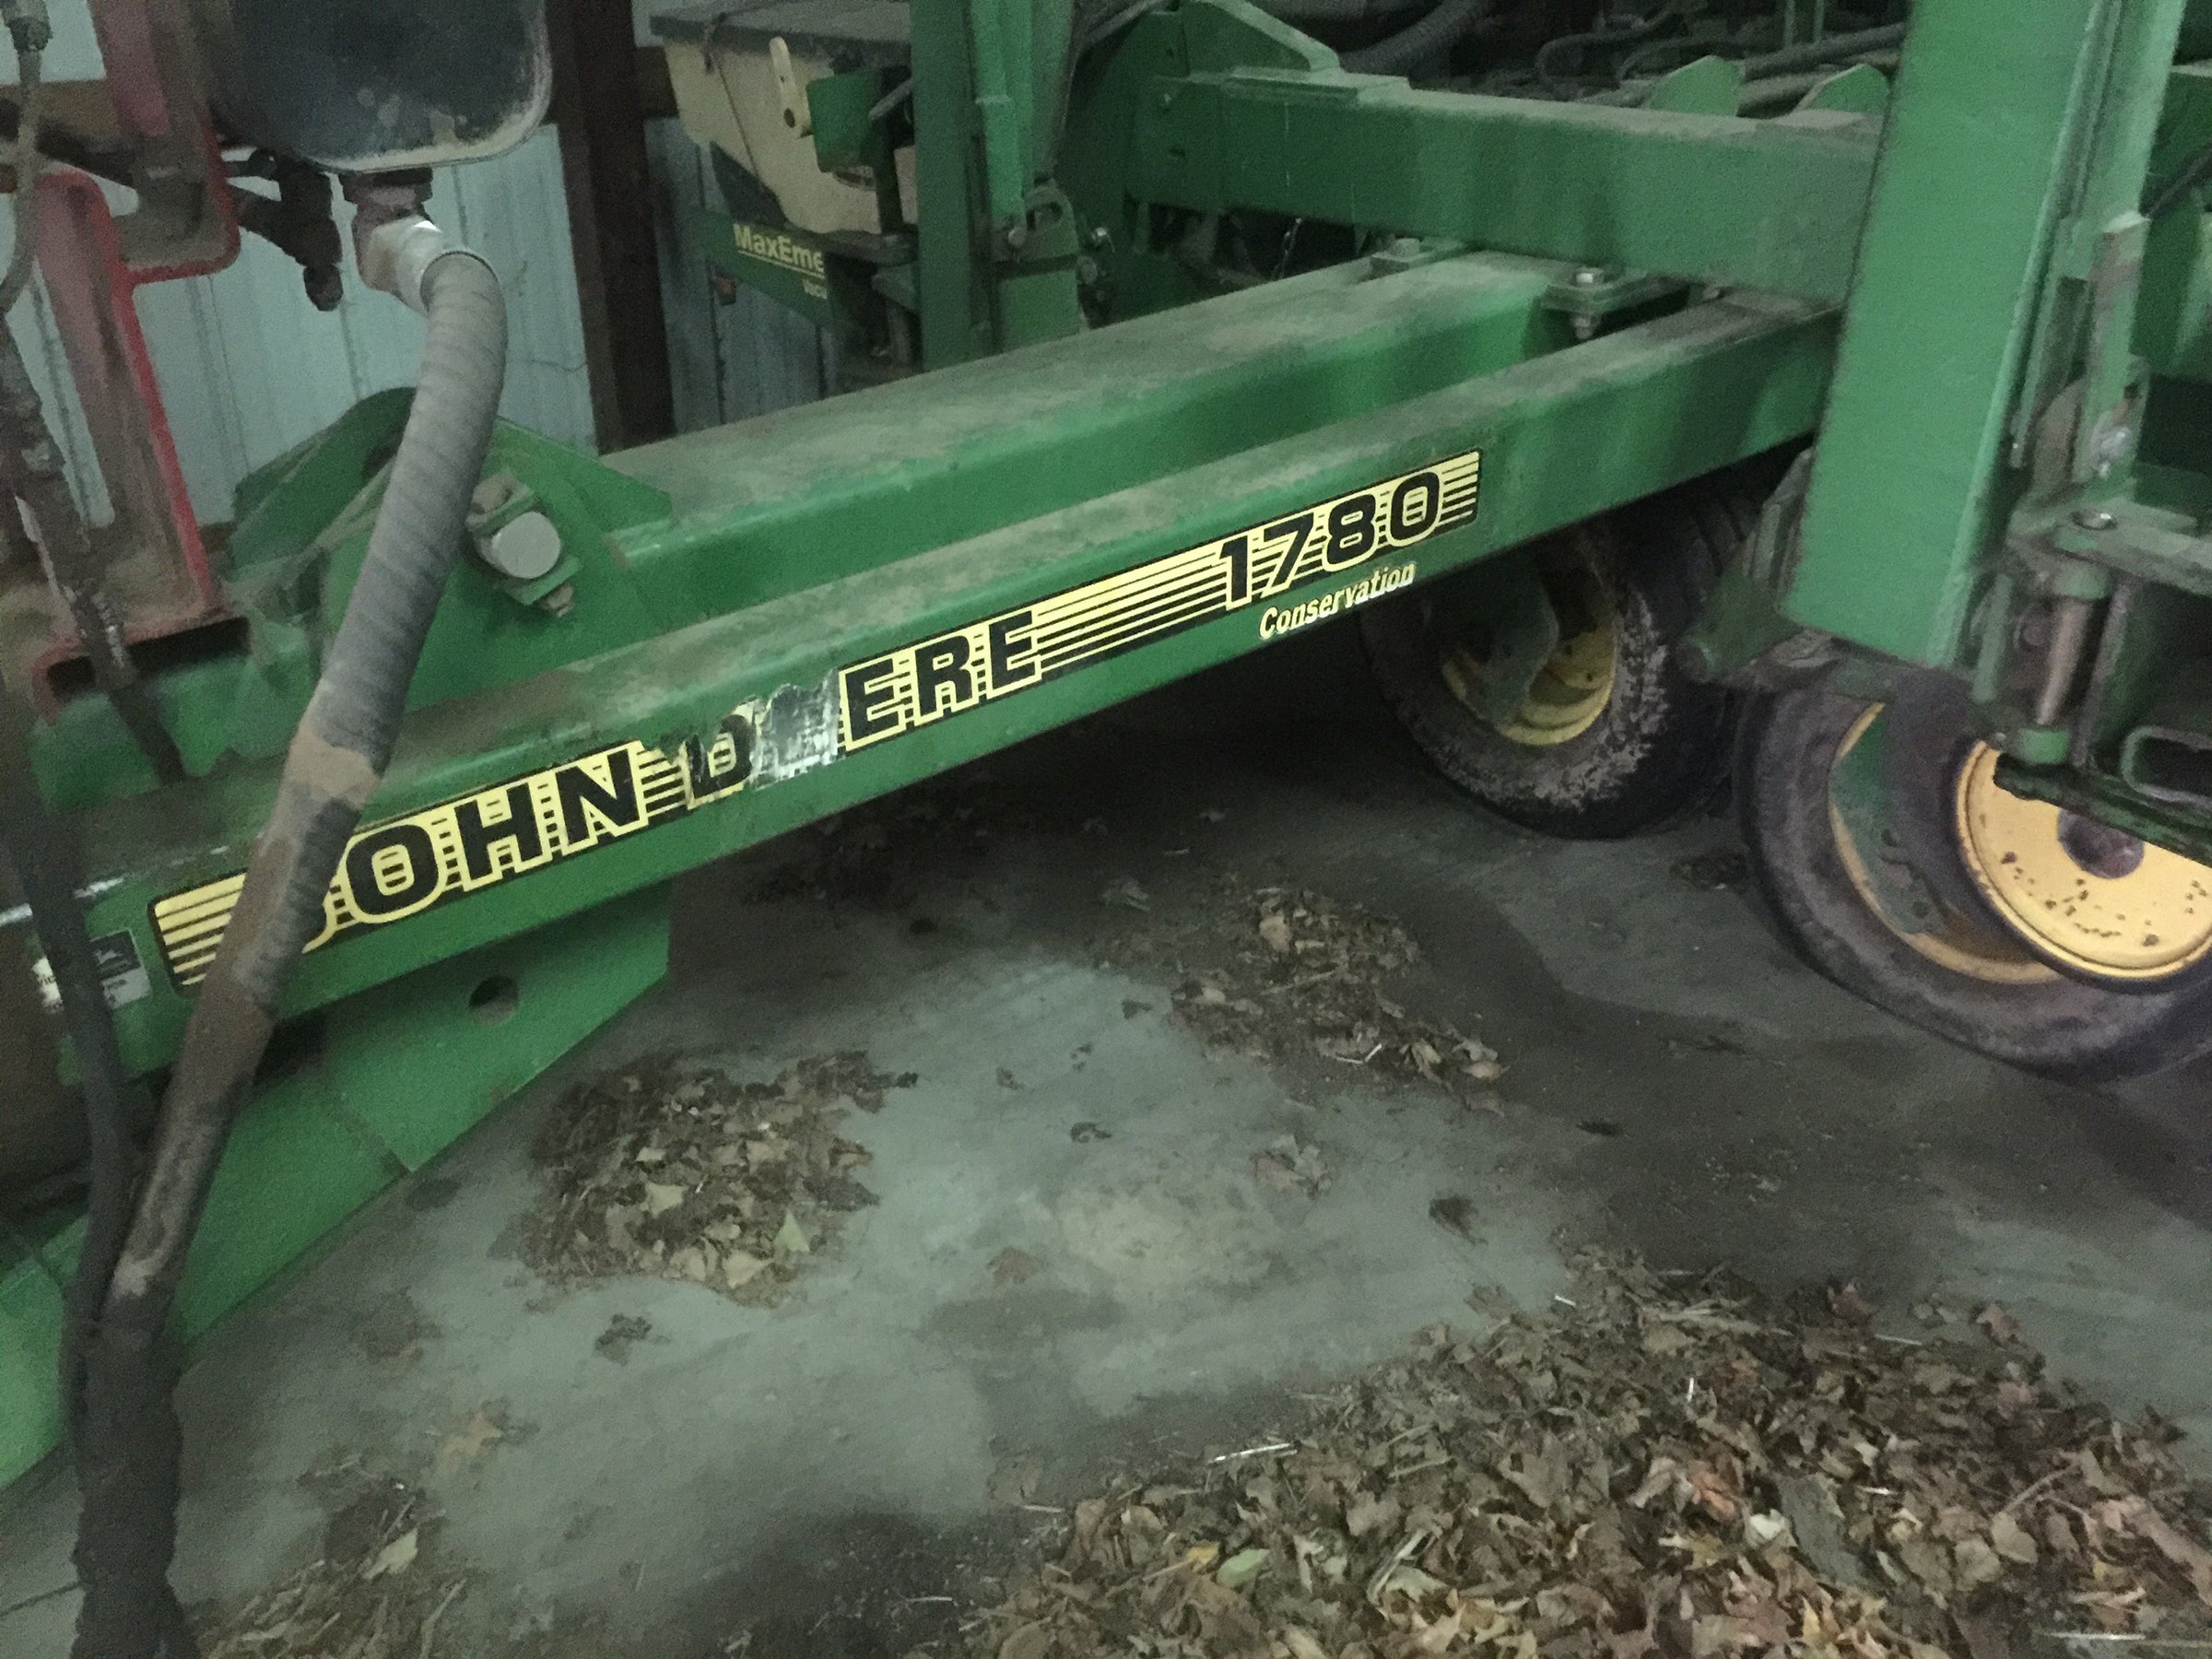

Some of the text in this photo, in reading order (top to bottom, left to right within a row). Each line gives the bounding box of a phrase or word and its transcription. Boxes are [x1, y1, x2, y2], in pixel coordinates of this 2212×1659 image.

[734, 223, 825, 274] MaxEme
[1258, 563, 1417, 640] Conservation
[308, 469, 1441, 949] OHN DERE 1780
